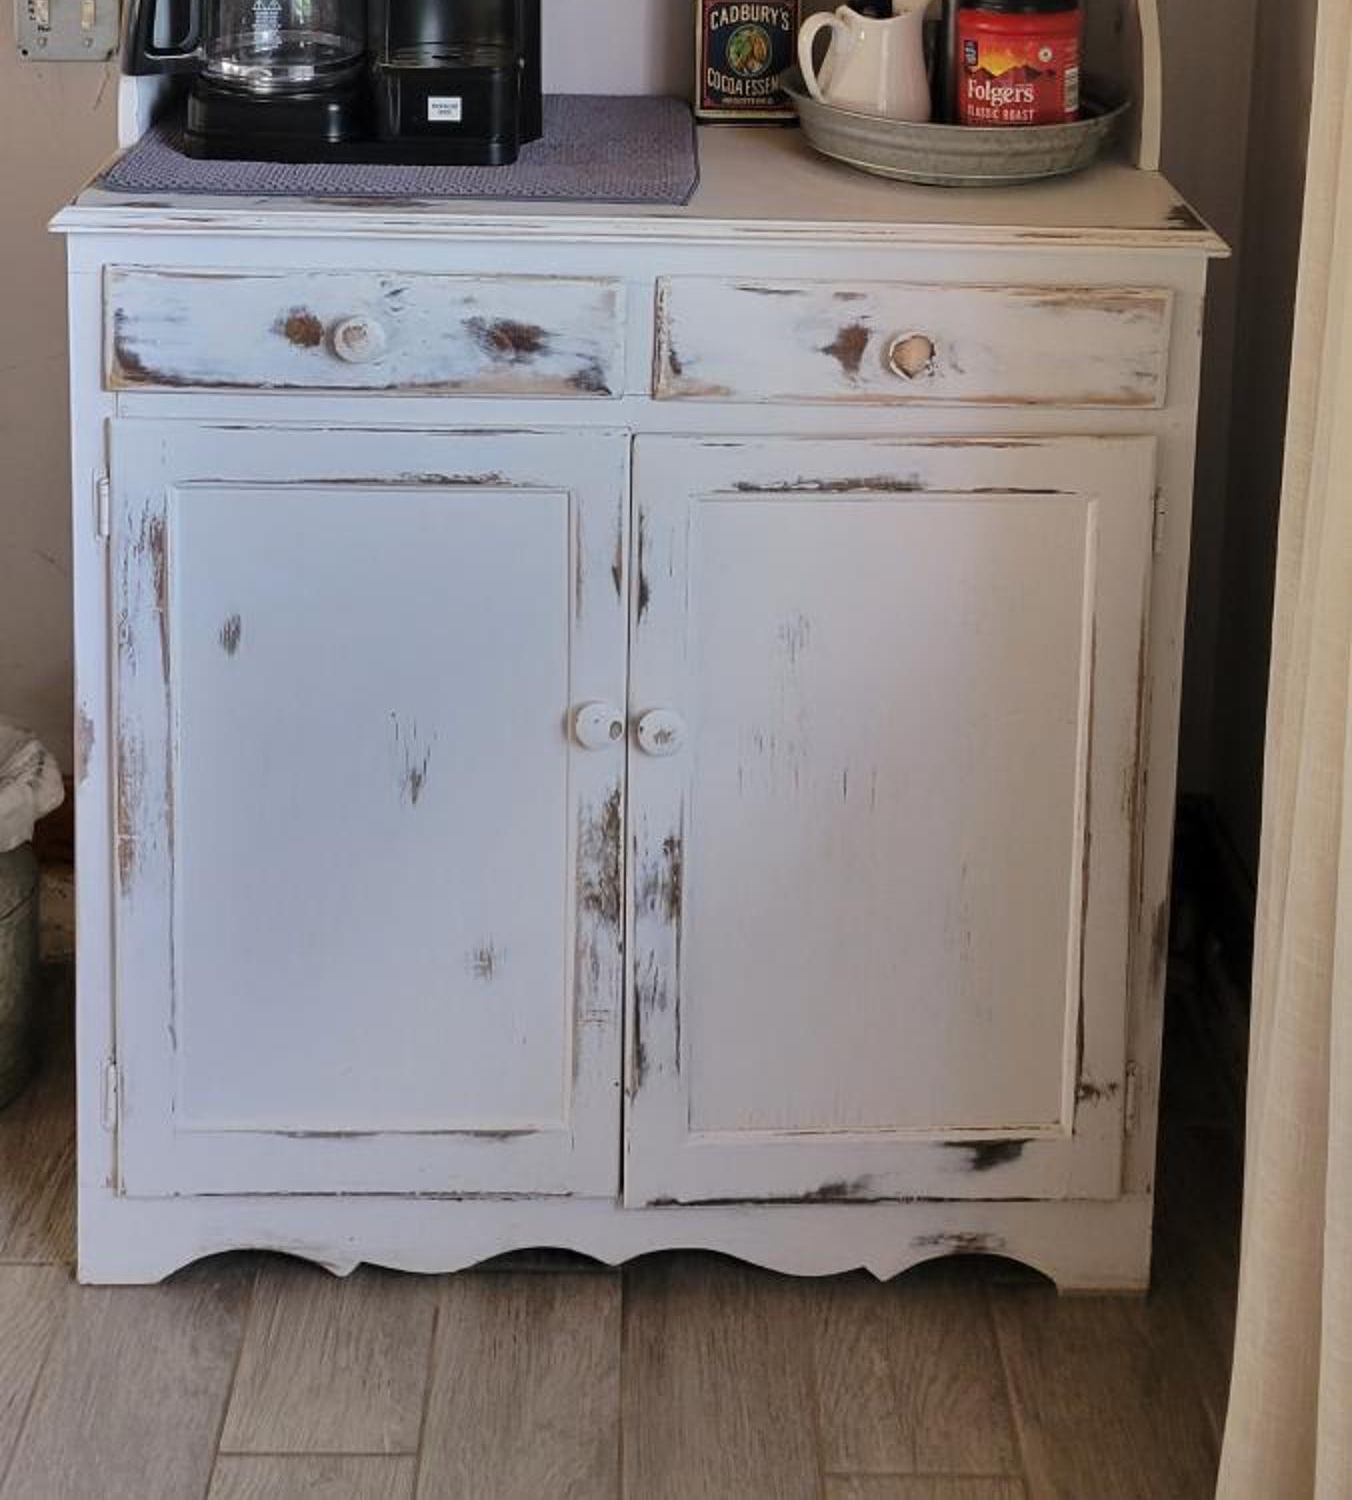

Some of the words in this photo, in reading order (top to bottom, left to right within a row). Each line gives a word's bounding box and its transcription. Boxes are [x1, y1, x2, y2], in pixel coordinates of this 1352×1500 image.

[710, 3, 790, 31] CADBURY'S
[707, 67, 743, 97] COCOA
[745, 75, 780, 97] ESSEN
[968, 78, 1035, 107] Folgers
